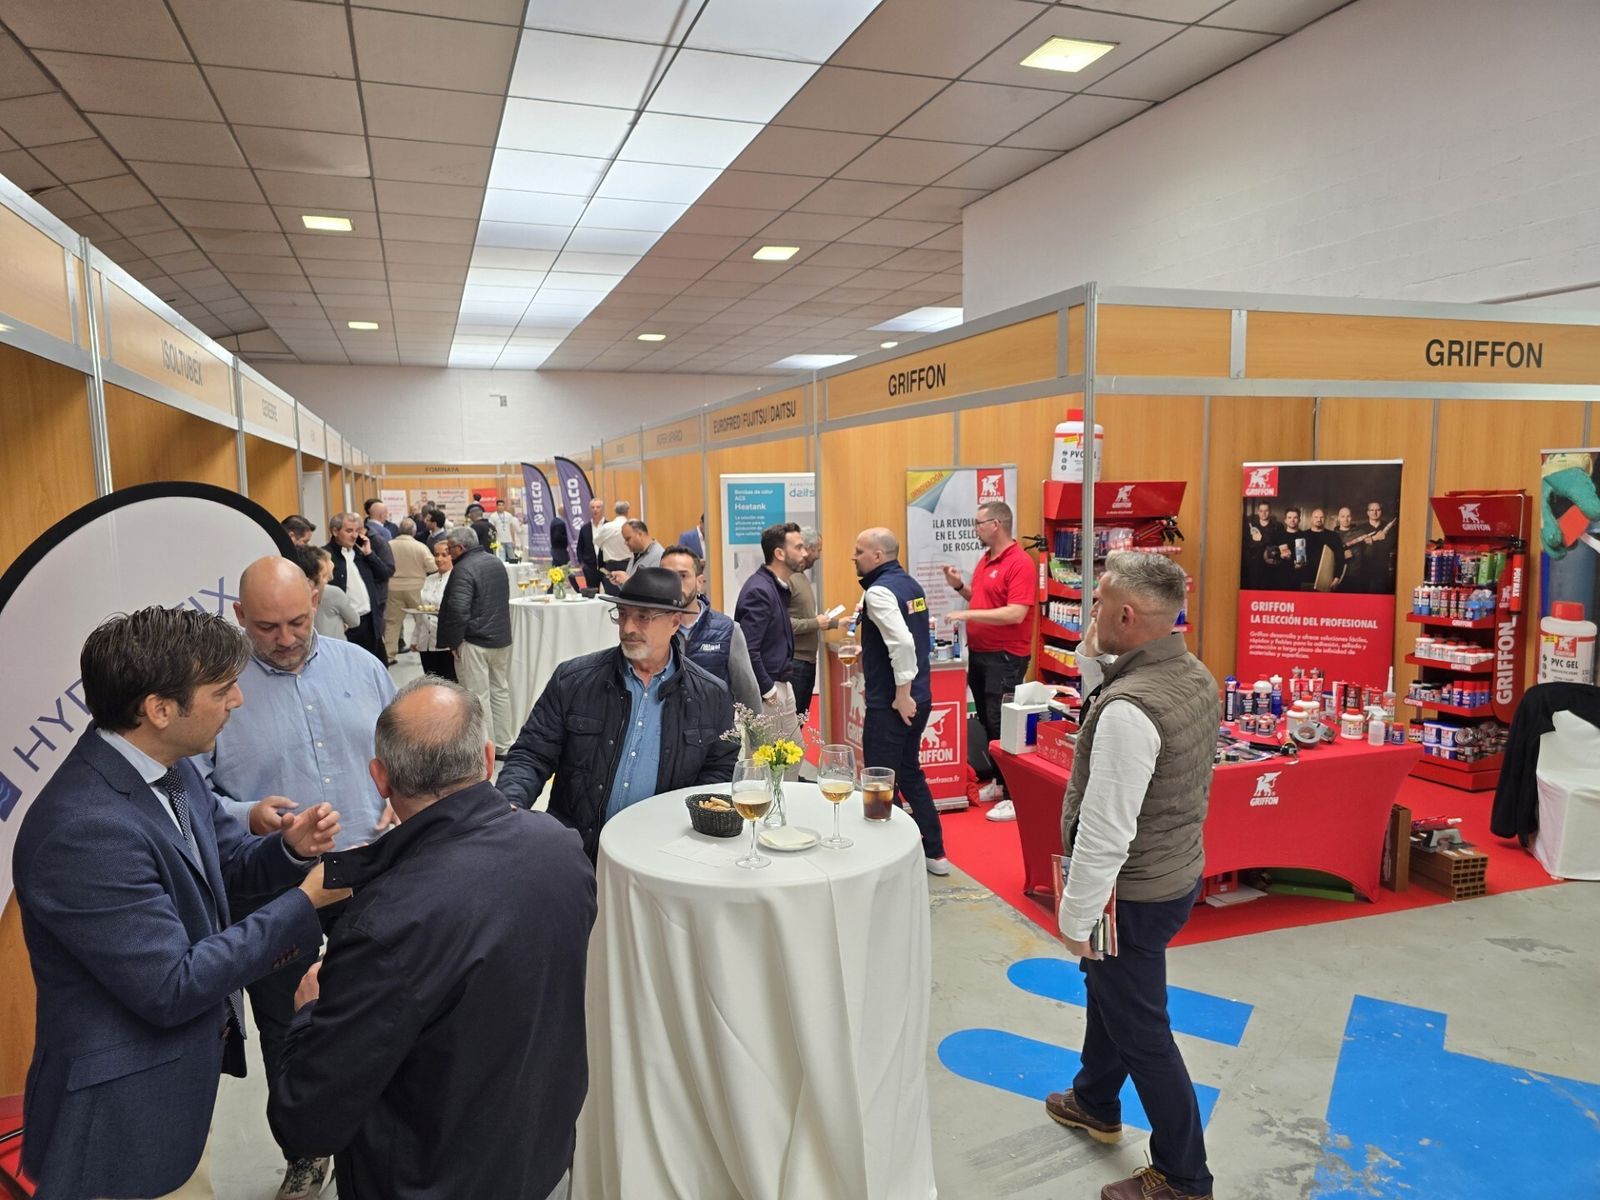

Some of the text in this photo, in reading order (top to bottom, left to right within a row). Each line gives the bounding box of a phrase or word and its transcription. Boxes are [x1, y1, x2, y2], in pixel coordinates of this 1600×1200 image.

[1425, 338, 1543, 368] GRIFFON
[888, 362, 946, 397] GRIFFON
[713, 414, 741, 434] EUROFRED
[743, 407, 767, 428] FUJITSU
[770, 399, 797, 422] DAITSU
[789, 488, 815, 498] daits
[1246, 487, 1274, 496] GRIFFON
[734, 502, 767, 510] Heatank
[947, 518, 977, 528] REVOLU
[1461, 523, 1491, 532] GRIFFON
[935, 529, 978, 541] EN EL SELL
[943, 543, 953, 552] DE
[1512, 582, 1521, 598] MAX
[1251, 601, 1295, 613] GRIFFON
[1250, 613, 1378, 629] LA ELECCIÓN DEL PROFESIONAL
[1497, 621, 1515, 705] GRIFFON
[1551, 657, 1579, 669] PVC GEL
[918, 747, 953, 763] RIFFON
[1249, 795, 1280, 807] GRIFFON
